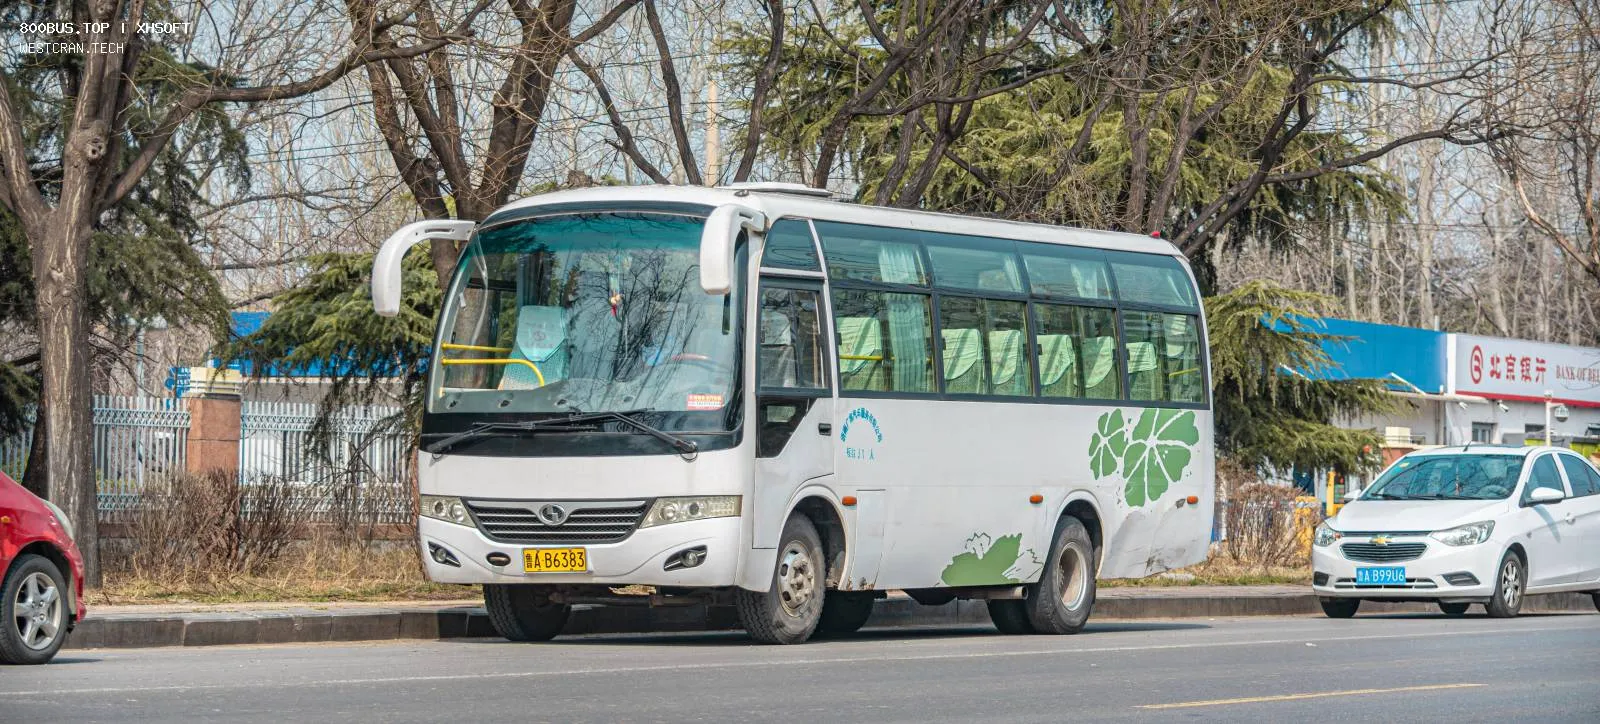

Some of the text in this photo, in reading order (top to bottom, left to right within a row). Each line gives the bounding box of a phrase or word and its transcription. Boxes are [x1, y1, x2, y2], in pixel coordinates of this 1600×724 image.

[1489, 353, 1547, 385] 北京银行
[1556, 364, 1575, 380] BANK
[1577, 367, 1587, 381] OF
